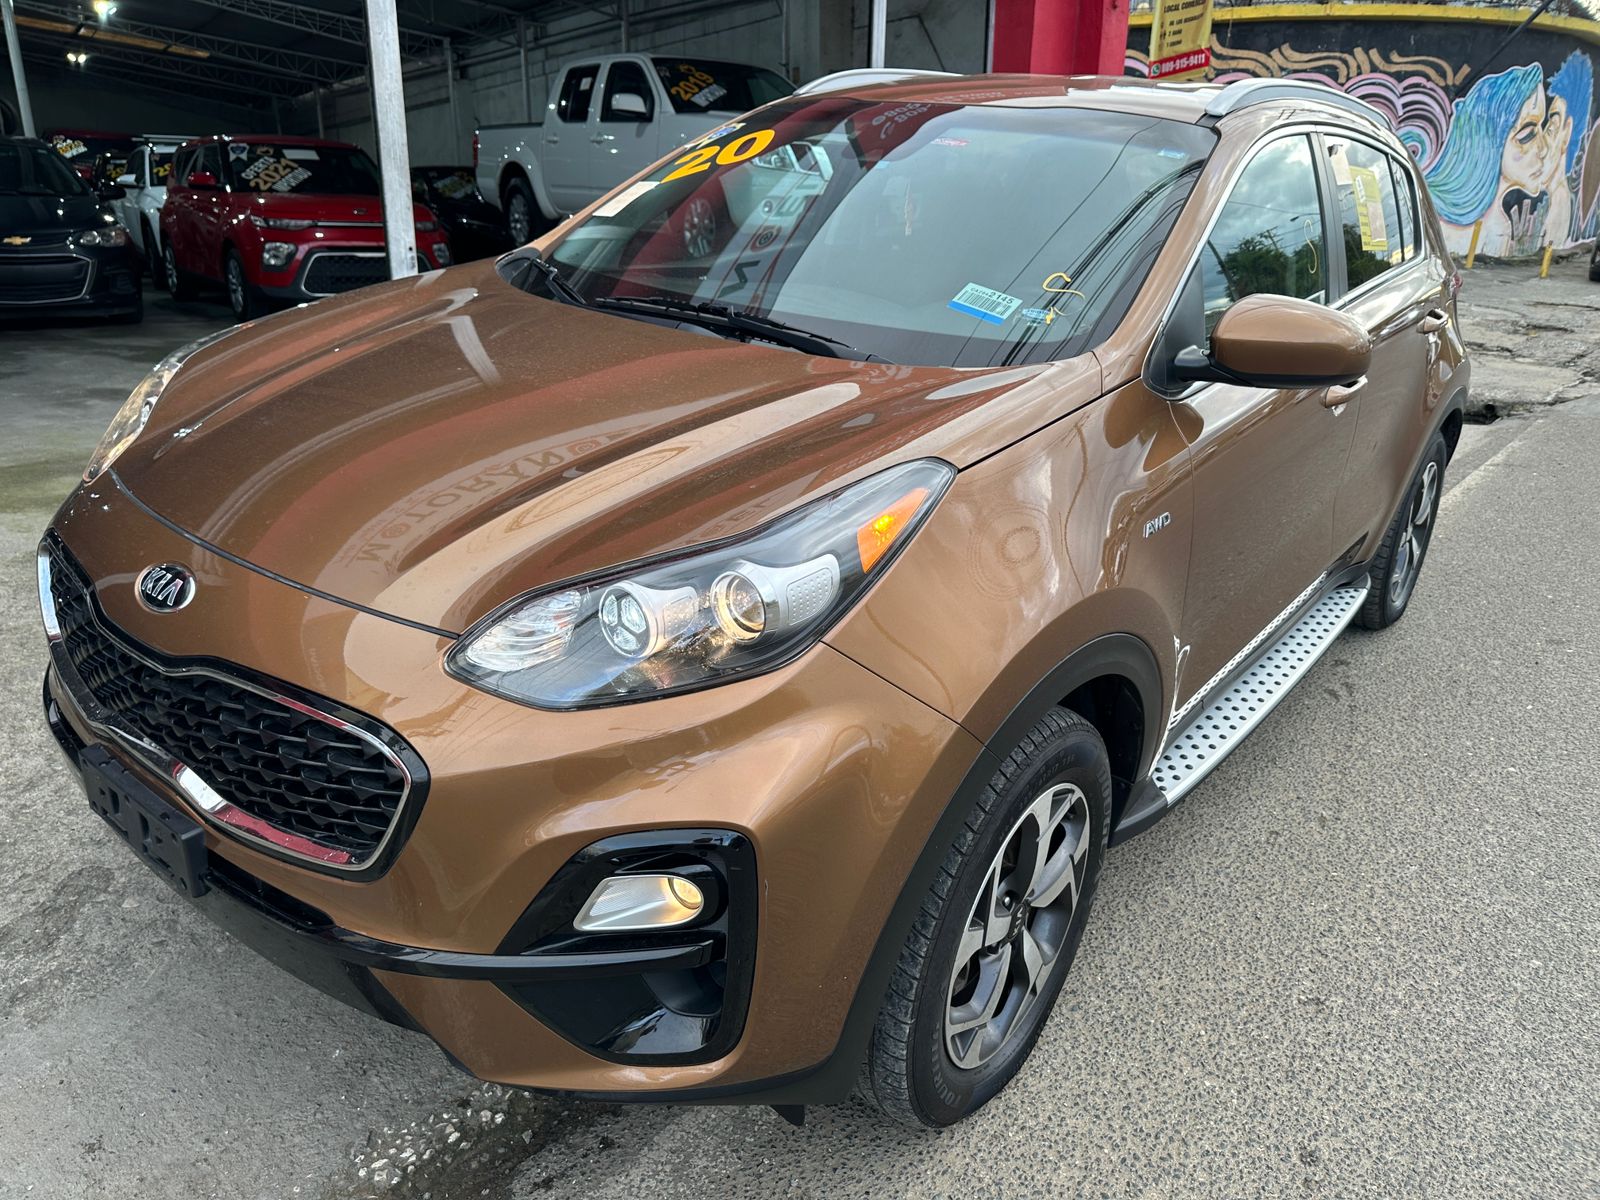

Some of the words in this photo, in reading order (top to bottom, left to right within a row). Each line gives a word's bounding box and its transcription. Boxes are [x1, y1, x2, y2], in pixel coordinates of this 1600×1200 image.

[1164, 4, 1180, 13] LOCAL
[671, 71, 714, 102] 2019
[659, 129, 776, 184] 20
[249, 158, 299, 191] 2021
[1143, 511, 1171, 538] AWD
[141, 567, 184, 606] KIA
